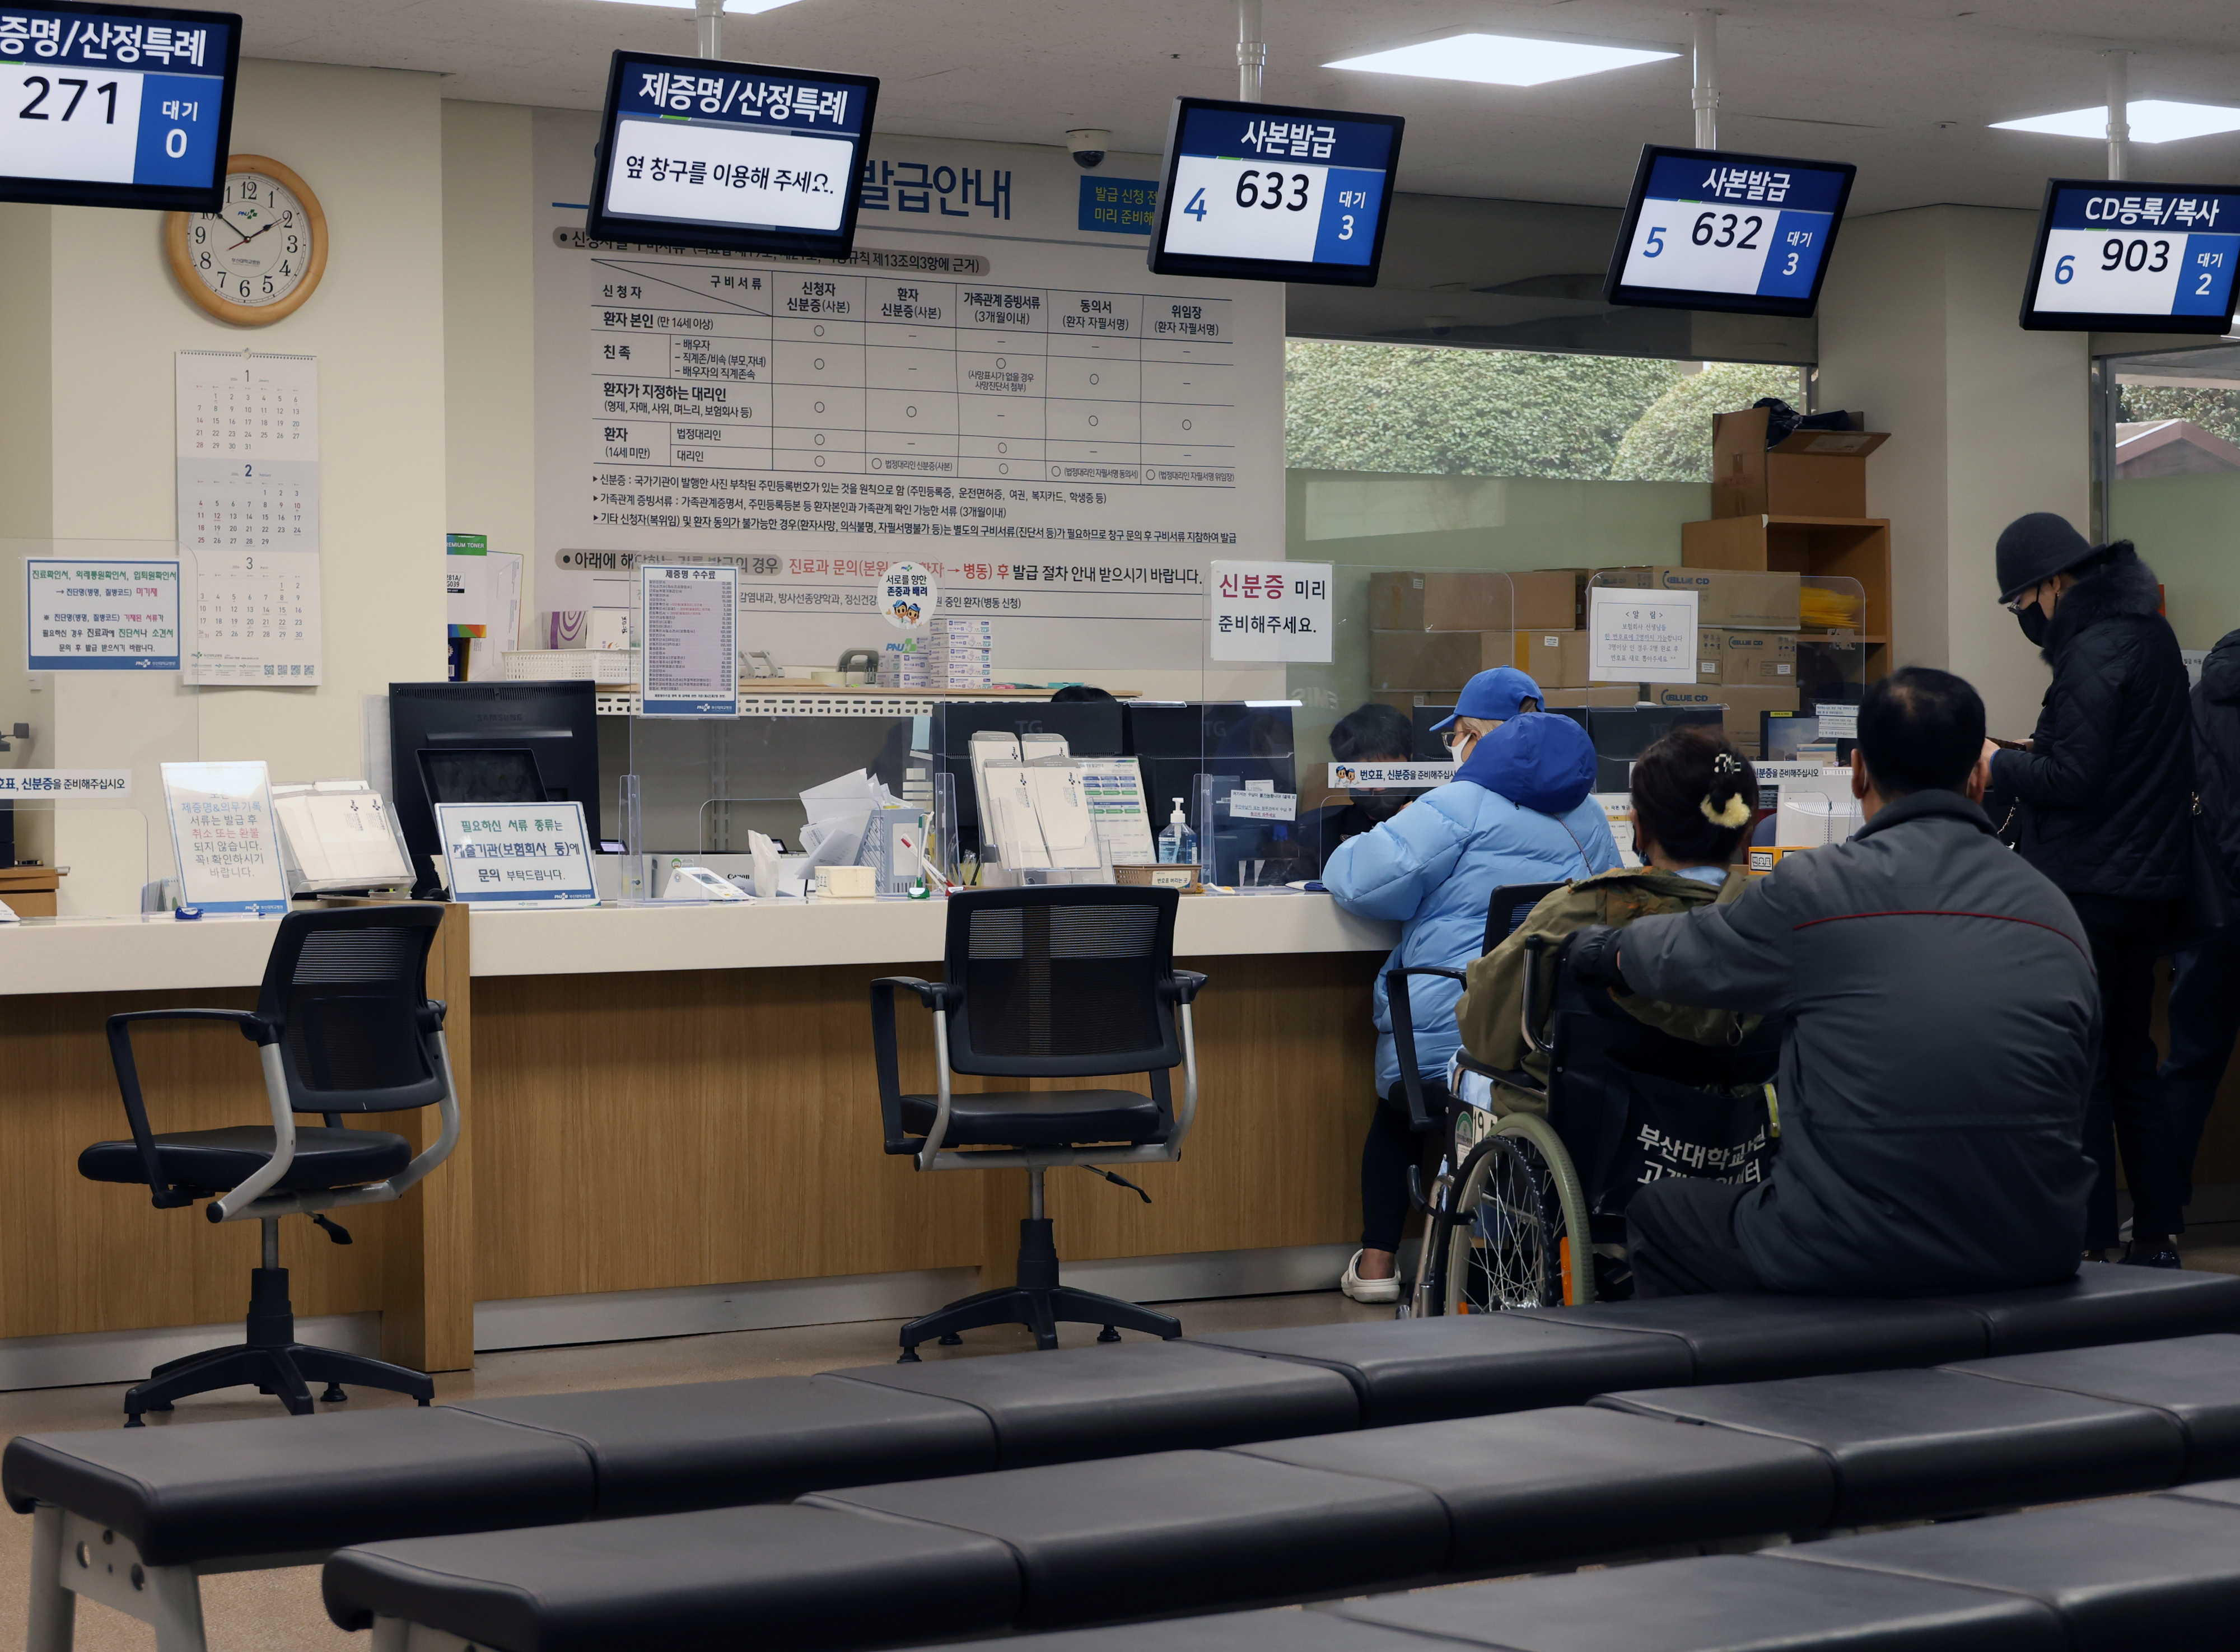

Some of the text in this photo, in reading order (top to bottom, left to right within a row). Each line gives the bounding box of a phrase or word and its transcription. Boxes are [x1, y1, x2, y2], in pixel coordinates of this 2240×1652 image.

[18, 76, 118, 124] 271
[639, 72, 848, 125] 제증명/산정특례
[162, 100, 198, 122] 대기
[166, 128, 188, 158] 0
[1241, 120, 1336, 158] 사본발급
[626, 156, 645, 180] 옆
[650, 157, 707, 185] 창구를
[713, 165, 769, 190] 이용해
[240, 181, 257, 199] 12
[1702, 167, 1791, 202] 사본발급
[268, 190, 274, 208] 1
[1096, 186, 1118, 202] 발급
[1122, 189, 1144, 204] 신청
[1183, 170, 1309, 222] 4 633
[1338, 190, 1366, 209] 대기
[282, 211, 292, 228] 2
[1095, 208, 1117, 223] 미리
[2085, 197, 2219, 227] CD등록/복사
[195, 226, 206, 244] 9
[1338, 214, 1355, 241] 3
[1642, 212, 1763, 258] 5 632
[287, 235, 298, 253] 3
[1787, 231, 1813, 248] 대기
[200, 252, 211, 269] 8
[279, 260, 291, 276] 4
[873, 253, 979, 273] 제13조의3항에 근거)
[1782, 253, 1799, 276] 3
[2055, 239, 2170, 285] 6 903
[2197, 252, 2223, 268] 대기
[217, 272, 226, 288] 7
[240, 280, 250, 297] 6
[262, 276, 273, 293] 5
[2195, 273, 2213, 295] 2
[801, 281, 836, 297] 신청자
[898, 288, 918, 302] 환자
[787, 297, 850, 314] 신분증(사본)
[964, 292, 1040, 309] 가족관계 증빙서류
[1080, 300, 1112, 314] 동의서
[604, 311, 654, 328] 환자 본인
[881, 302, 941, 320] 신분증(사본)
[975, 311, 1030, 325] (3개월이내)
[1172, 305, 1202, 319] 위임장
[245, 370, 249, 382] 1
[604, 382, 726, 402] 환자가 지정하는 대리인
[677, 429, 721, 441] 법정대리인
[245, 465, 252, 477] 2
[600, 474, 904, 496] 신분증 국가기관이 발행한 사진 부착된 주민등록번호가 있는 것을 원칙으로 함
[246, 557, 253, 569] 3
[575, 552, 615, 569] 아래에
[752, 558, 778, 573] 경우
[788, 558, 829, 575] 진료과
[964, 563, 992, 580] 병동)
[996, 564, 1009, 579] 후
[1012, 564, 1039, 581] 발급
[1042, 566, 1068, 581] 절차
[1071, 567, 1096, 582] 안내
[1099, 568, 1147, 583] 받으시기
[1151, 568, 1202, 585] 바랍니다.
[32, 570, 176, 581] 진료확인서, 외래통원확인서, 입퇴원확인서
[665, 570, 716, 579] 제증명 수수료
[886, 575, 927, 585] 서로를 향한
[137, 588, 157, 596] 미기재
[887, 586, 927, 596] 존중과 배려
[1219, 573, 1326, 600] 신분증 미리
[87, 628, 114, 637] 진료과에
[119, 628, 147, 637] 진단서나
[152, 628, 173, 637] 소견서
[1218, 614, 1317, 635] 준비해주세요.
[1015, 720, 1043, 735] TG
[1202, 721, 1226, 736] TG
[1360, 769, 1385, 781] 번호표,
[1387, 769, 1416, 780] 신분증을
[1779, 769, 1819, 778] 준비해주십시오
[22, 778, 62, 790] 신분증을
[64, 778, 125, 790] 준비해주십시오
[181, 801, 262, 813] 제증명&의무기록
[190, 815, 257, 826] 서류는 발급 후
[461, 819, 563, 832] 필요하신 서류 종류는
[192, 828, 259, 839] 취소 또는 환불
[194, 841, 262, 852] 되지 않습니다.
[453, 842, 580, 858] 제출기관(보험회사 등)에
[196, 853, 264, 865] 꼭! 확인하시기
[210, 867, 254, 878] 바랍니다.
[478, 869, 565, 882] 문의 부탁드립니다.
